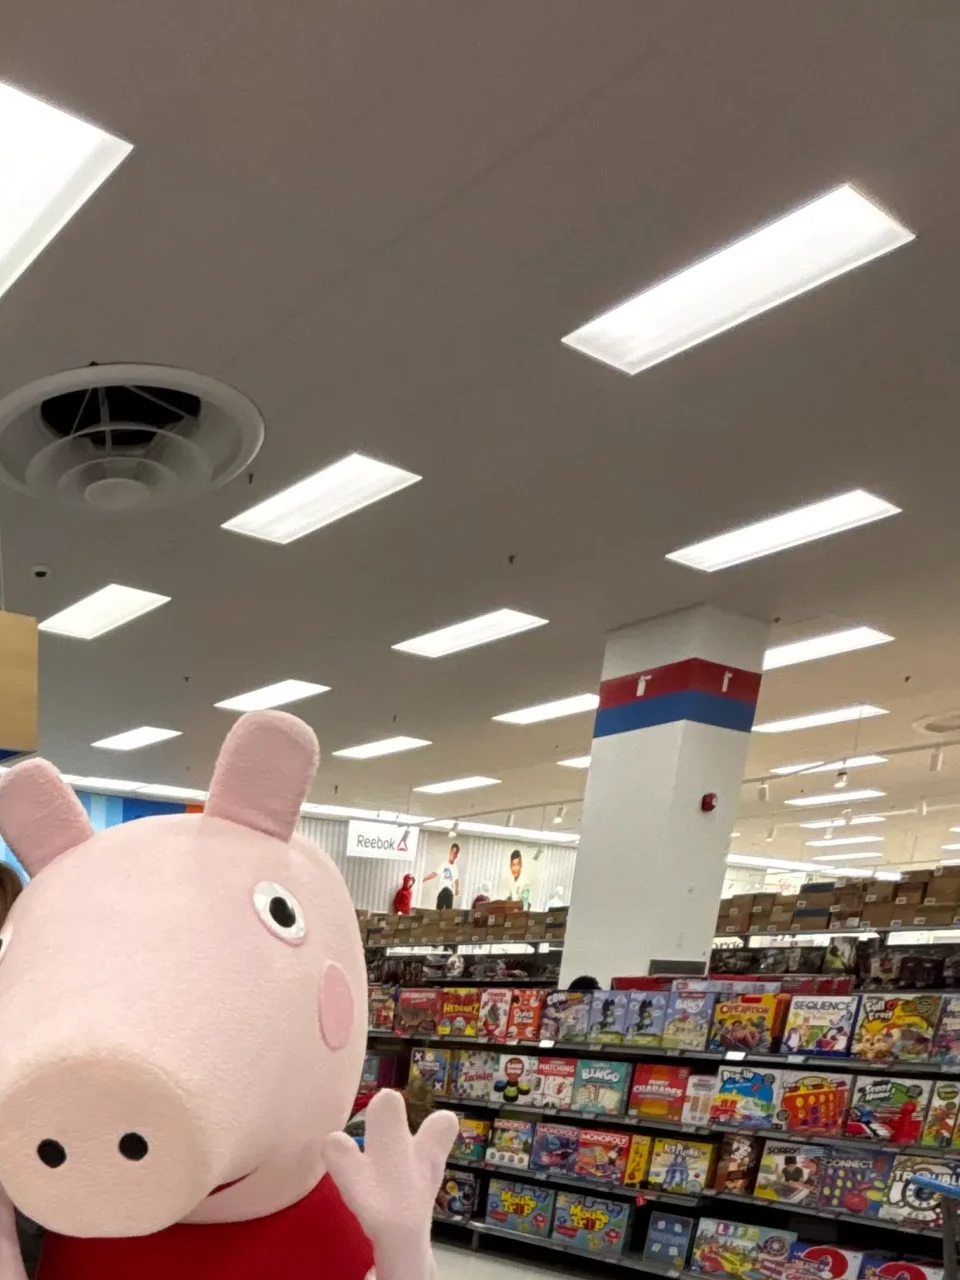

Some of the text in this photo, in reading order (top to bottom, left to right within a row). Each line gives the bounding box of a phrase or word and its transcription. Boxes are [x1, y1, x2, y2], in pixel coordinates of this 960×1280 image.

[357, 834, 395, 851] Reebok
[720, 1004, 770, 1014] OPERATION
[793, 1001, 853, 1011] SEQUENCE
[539, 1064, 575, 1074] MATCHING
[581, 1068, 620, 1082] BINGO
[633, 1084, 683, 1097] CHARADES
[495, 1119, 530, 1130] MONOPOLY
[540, 1127, 578, 1137] MONOPOLY
[581, 1132, 627, 1145] MONOPOLY
[825, 1159, 874, 1169] CONNECT
